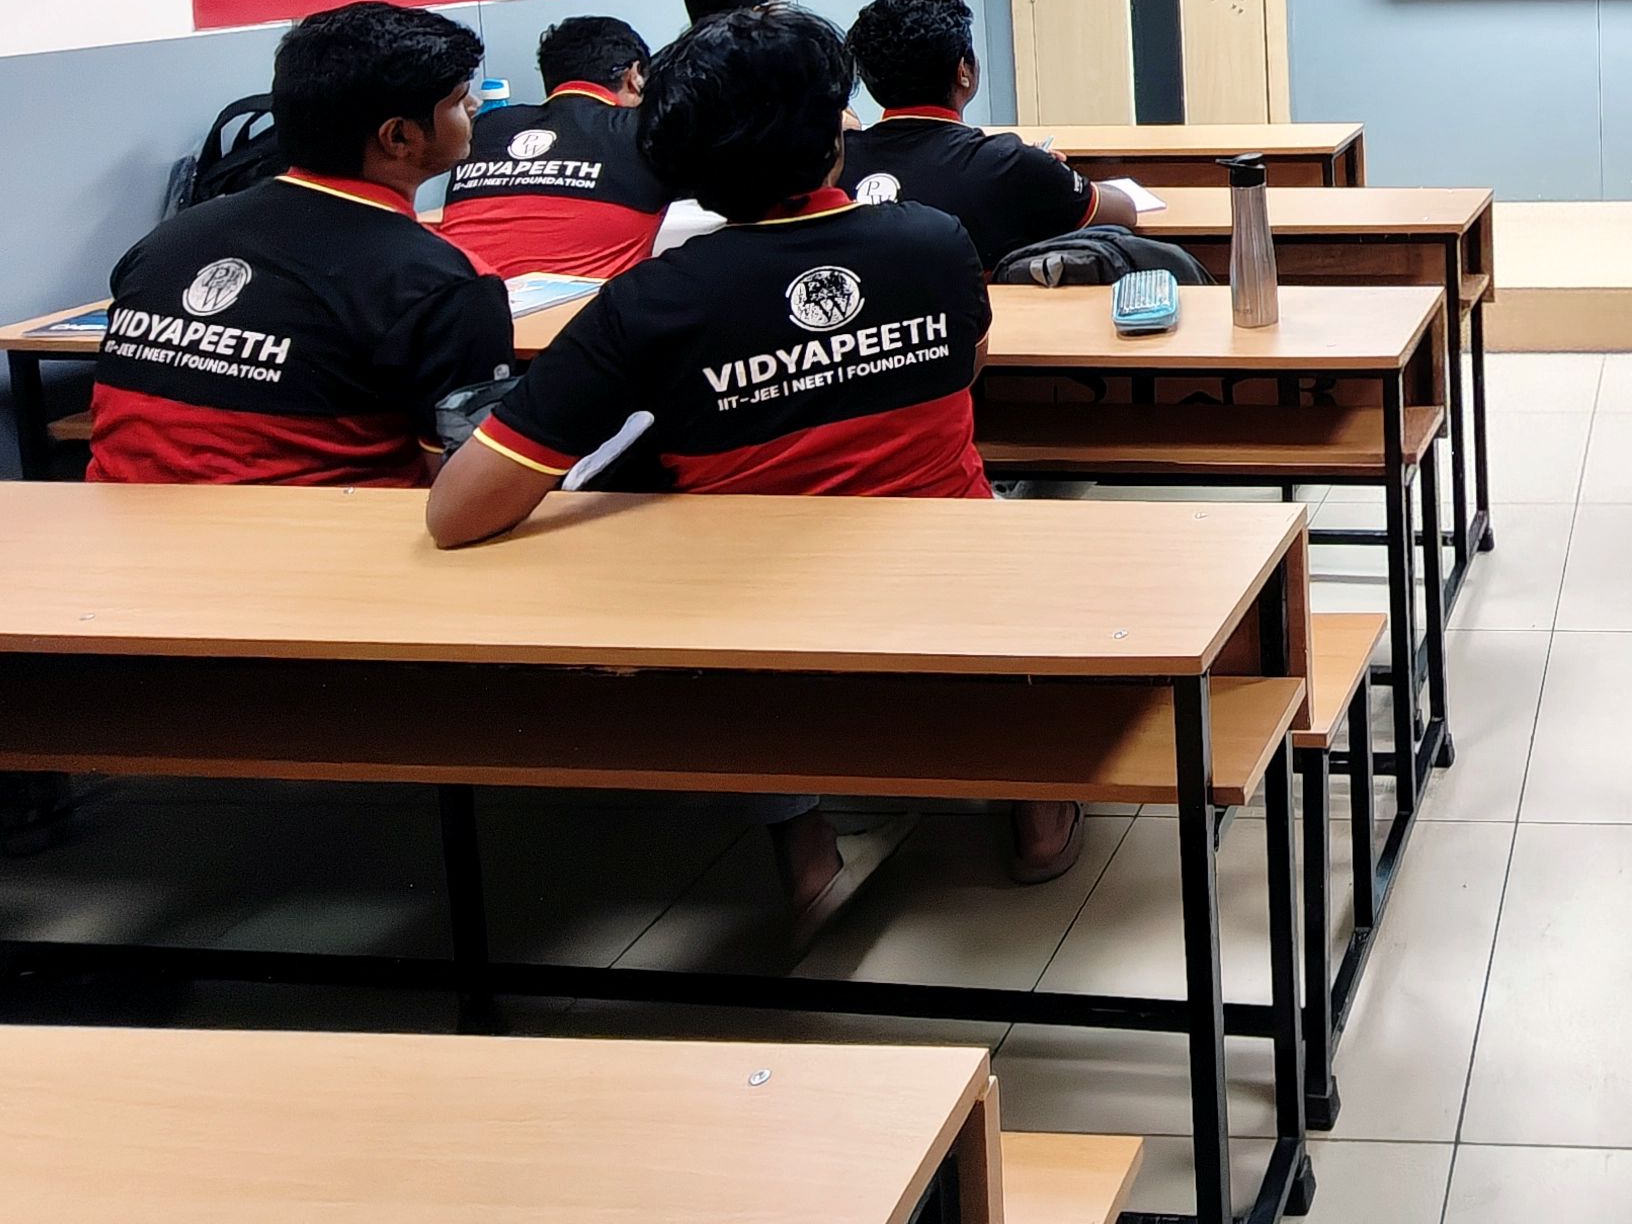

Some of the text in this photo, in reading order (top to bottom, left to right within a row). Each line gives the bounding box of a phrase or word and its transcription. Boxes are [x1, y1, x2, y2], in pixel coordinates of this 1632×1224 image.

[456, 160, 601, 181] VIDYAPEETH
[515, 176, 596, 189] FOUNDATION
[109, 307, 291, 364] VIDYAPEETH
[702, 313, 948, 393] VIDYAPEETH
[142, 345, 176, 365] NEET
[181, 353, 282, 383] FOUNDATION
[717, 344, 950, 411] IIT-JEE NEET FOUNDATION
